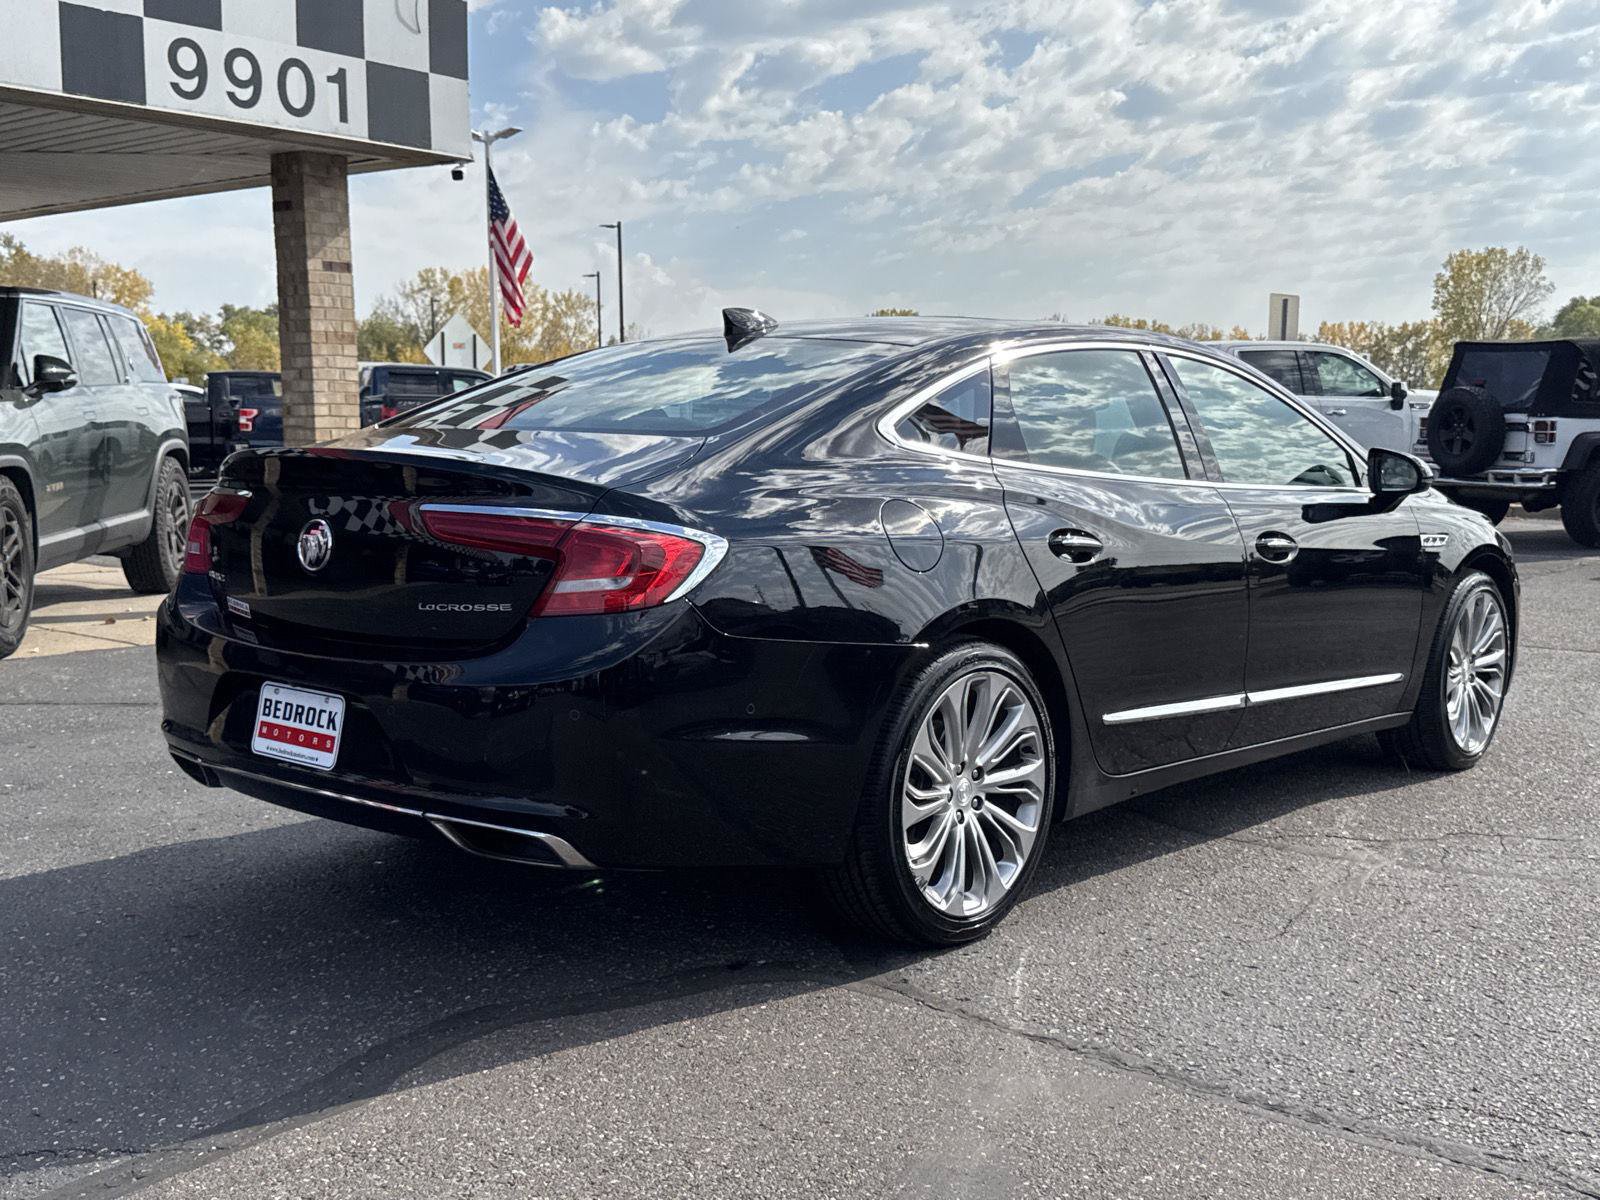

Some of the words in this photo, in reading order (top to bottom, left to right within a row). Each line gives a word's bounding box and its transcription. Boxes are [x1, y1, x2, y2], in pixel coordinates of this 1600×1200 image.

[167, 37, 349, 124] 9901
[262, 698, 337, 731] BEDROCK
[261, 726, 331, 749] MOTORS
